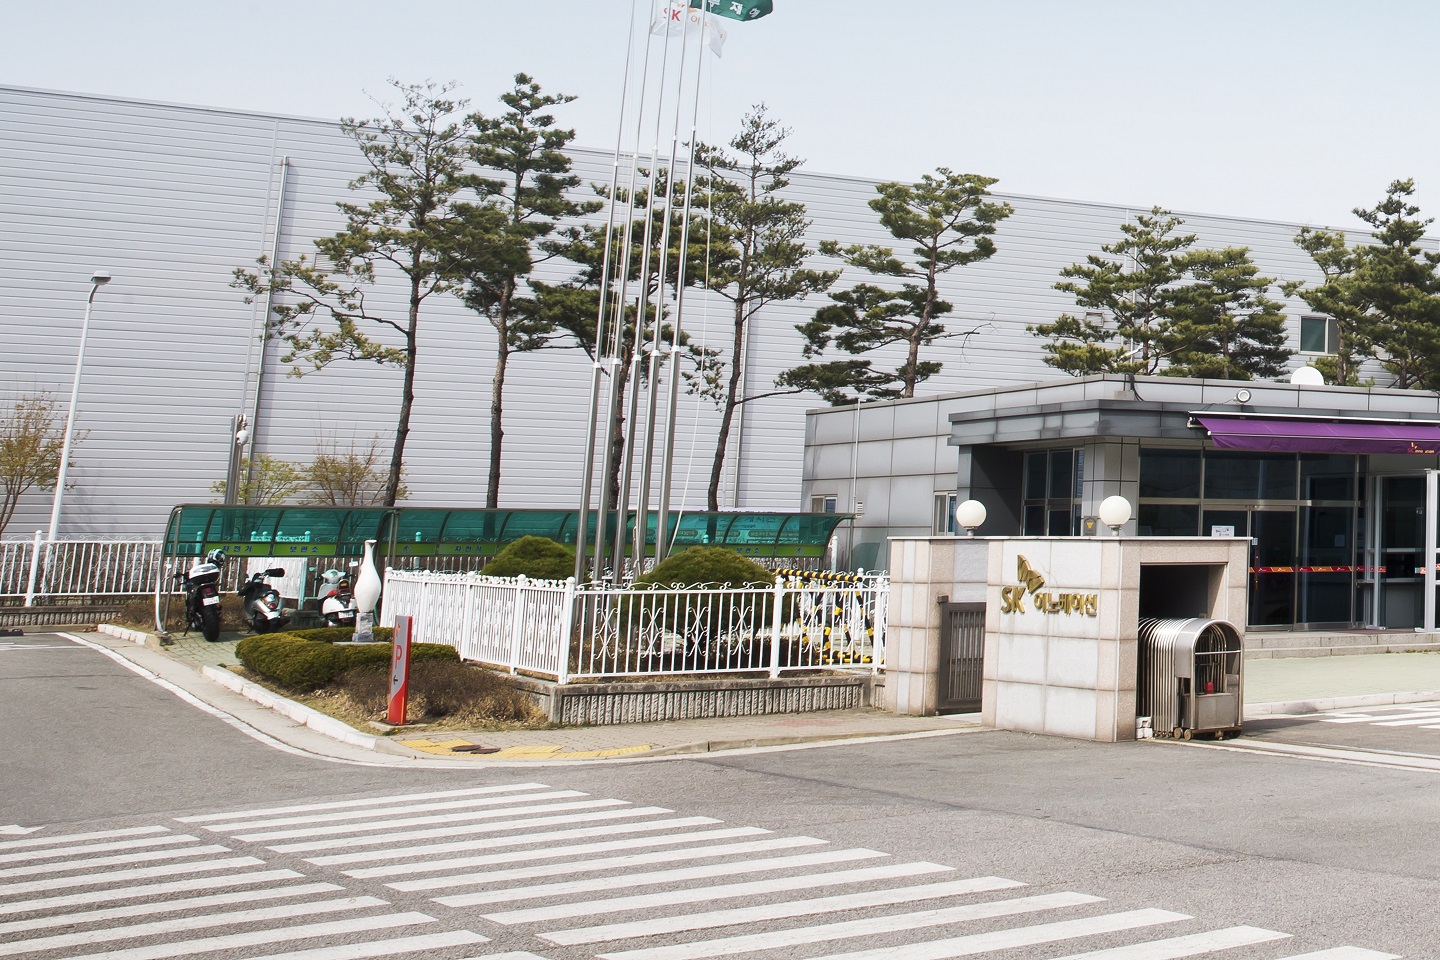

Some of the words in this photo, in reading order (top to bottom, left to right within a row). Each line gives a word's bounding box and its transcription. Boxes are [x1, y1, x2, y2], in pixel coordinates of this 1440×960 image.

[222, 545, 252, 553] 자전거
[289, 545, 319, 553] 보관소
[1001, 586, 1026, 613] SK
[1034, 592, 1098, 617] 이노베이션
[395, 645, 402, 669] P
